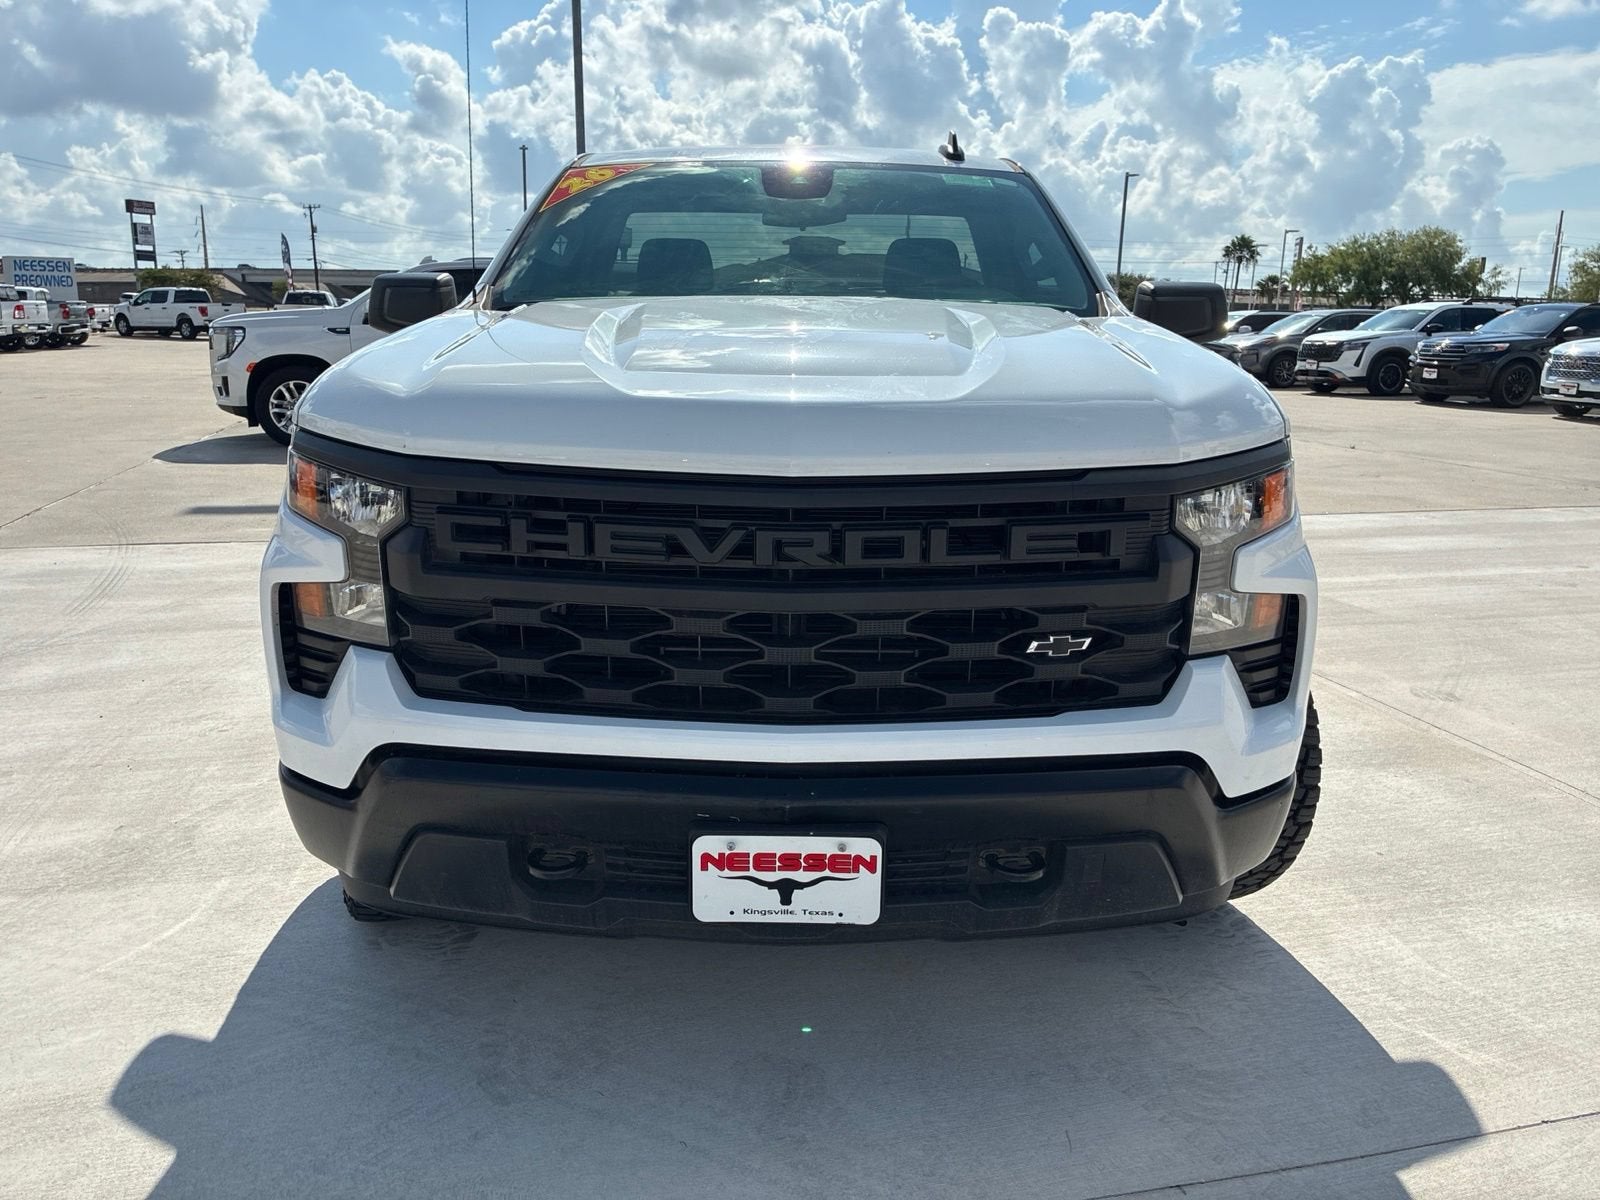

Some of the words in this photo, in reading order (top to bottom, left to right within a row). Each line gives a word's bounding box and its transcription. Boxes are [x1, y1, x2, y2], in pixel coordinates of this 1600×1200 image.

[13, 260, 71, 273] NEESSEN
[14, 273, 73, 288] PREOWNED
[435, 511, 1150, 566] CHEVROLET
[700, 852, 877, 874] NEESSEN
